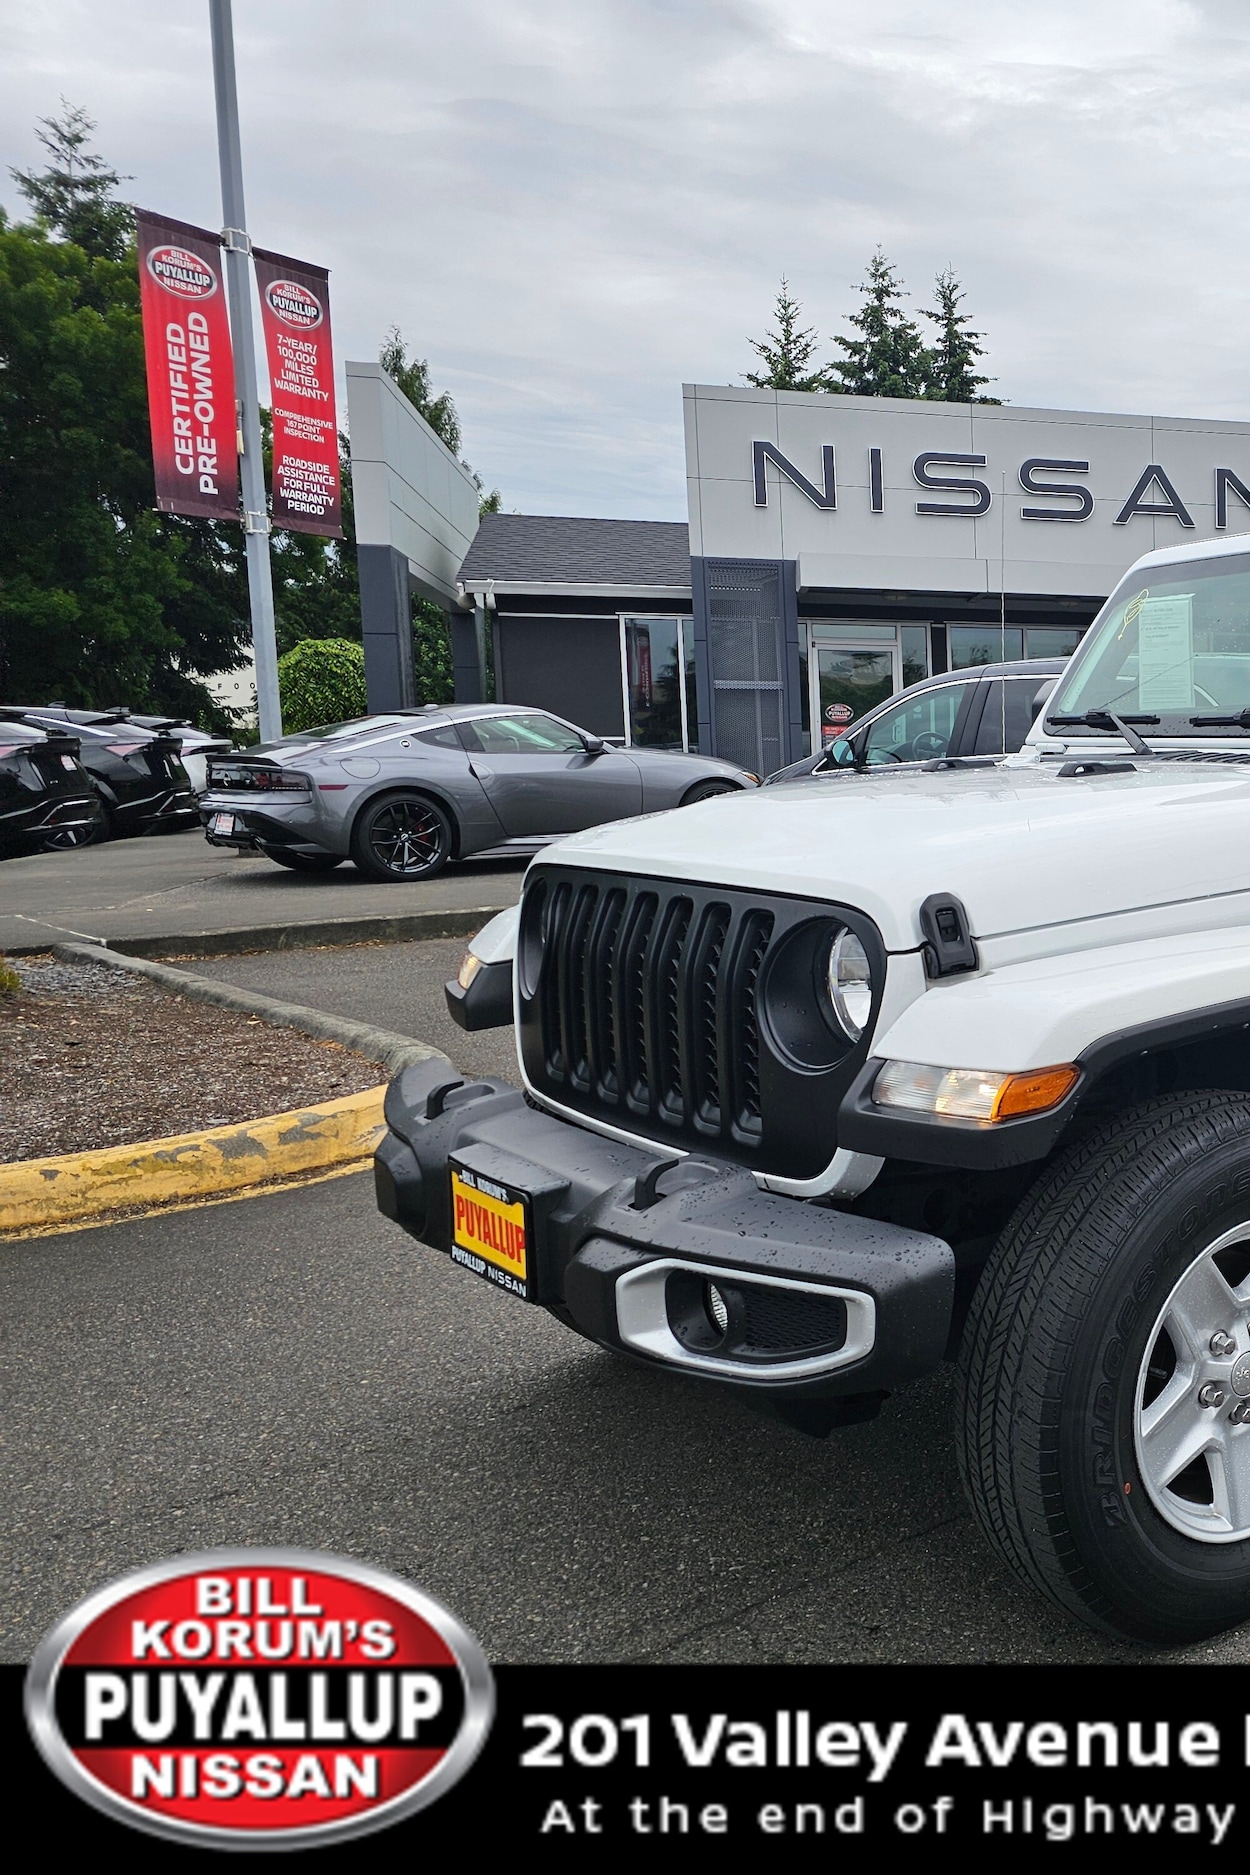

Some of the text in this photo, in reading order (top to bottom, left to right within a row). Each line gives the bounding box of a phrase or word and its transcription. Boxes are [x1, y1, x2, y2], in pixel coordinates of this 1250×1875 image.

[161, 254, 202, 272] KORUM'S
[171, 249, 190, 262] BILL
[155, 261, 211, 287] PUYALLUP
[163, 277, 202, 294] NISSAN
[276, 288, 311, 304] KORUM'S
[284, 284, 301, 295] BILL
[272, 294, 318, 318] PUYALLUP
[278, 309, 310, 325] NISSAN
[276, 333, 318, 355] 7-YEAR/
[277, 345, 317, 366] 100,000
[281, 368, 319, 388] LIMITED
[284, 359, 314, 376] MILES
[166, 323, 194, 475] CERTIFIED
[274, 377, 329, 402] WARRANTY
[187, 312, 219, 495] PRE-OWNED
[274, 407, 334, 430] COMPREHENSIVE
[297, 420, 321, 434] POINT
[283, 426, 325, 444] INSPECTION
[282, 454, 330, 475] ROADSIDE
[277, 465, 336, 487] ASSISTANCE
[283, 477, 329, 495] FOR FULL
[279, 486, 335, 507] WARRANTY
[287, 499, 325, 515] PERIOD
[455, 1193, 527, 1264] PUYALLUP
[451, 1244, 527, 1298] PUYALLUP NISSAN
